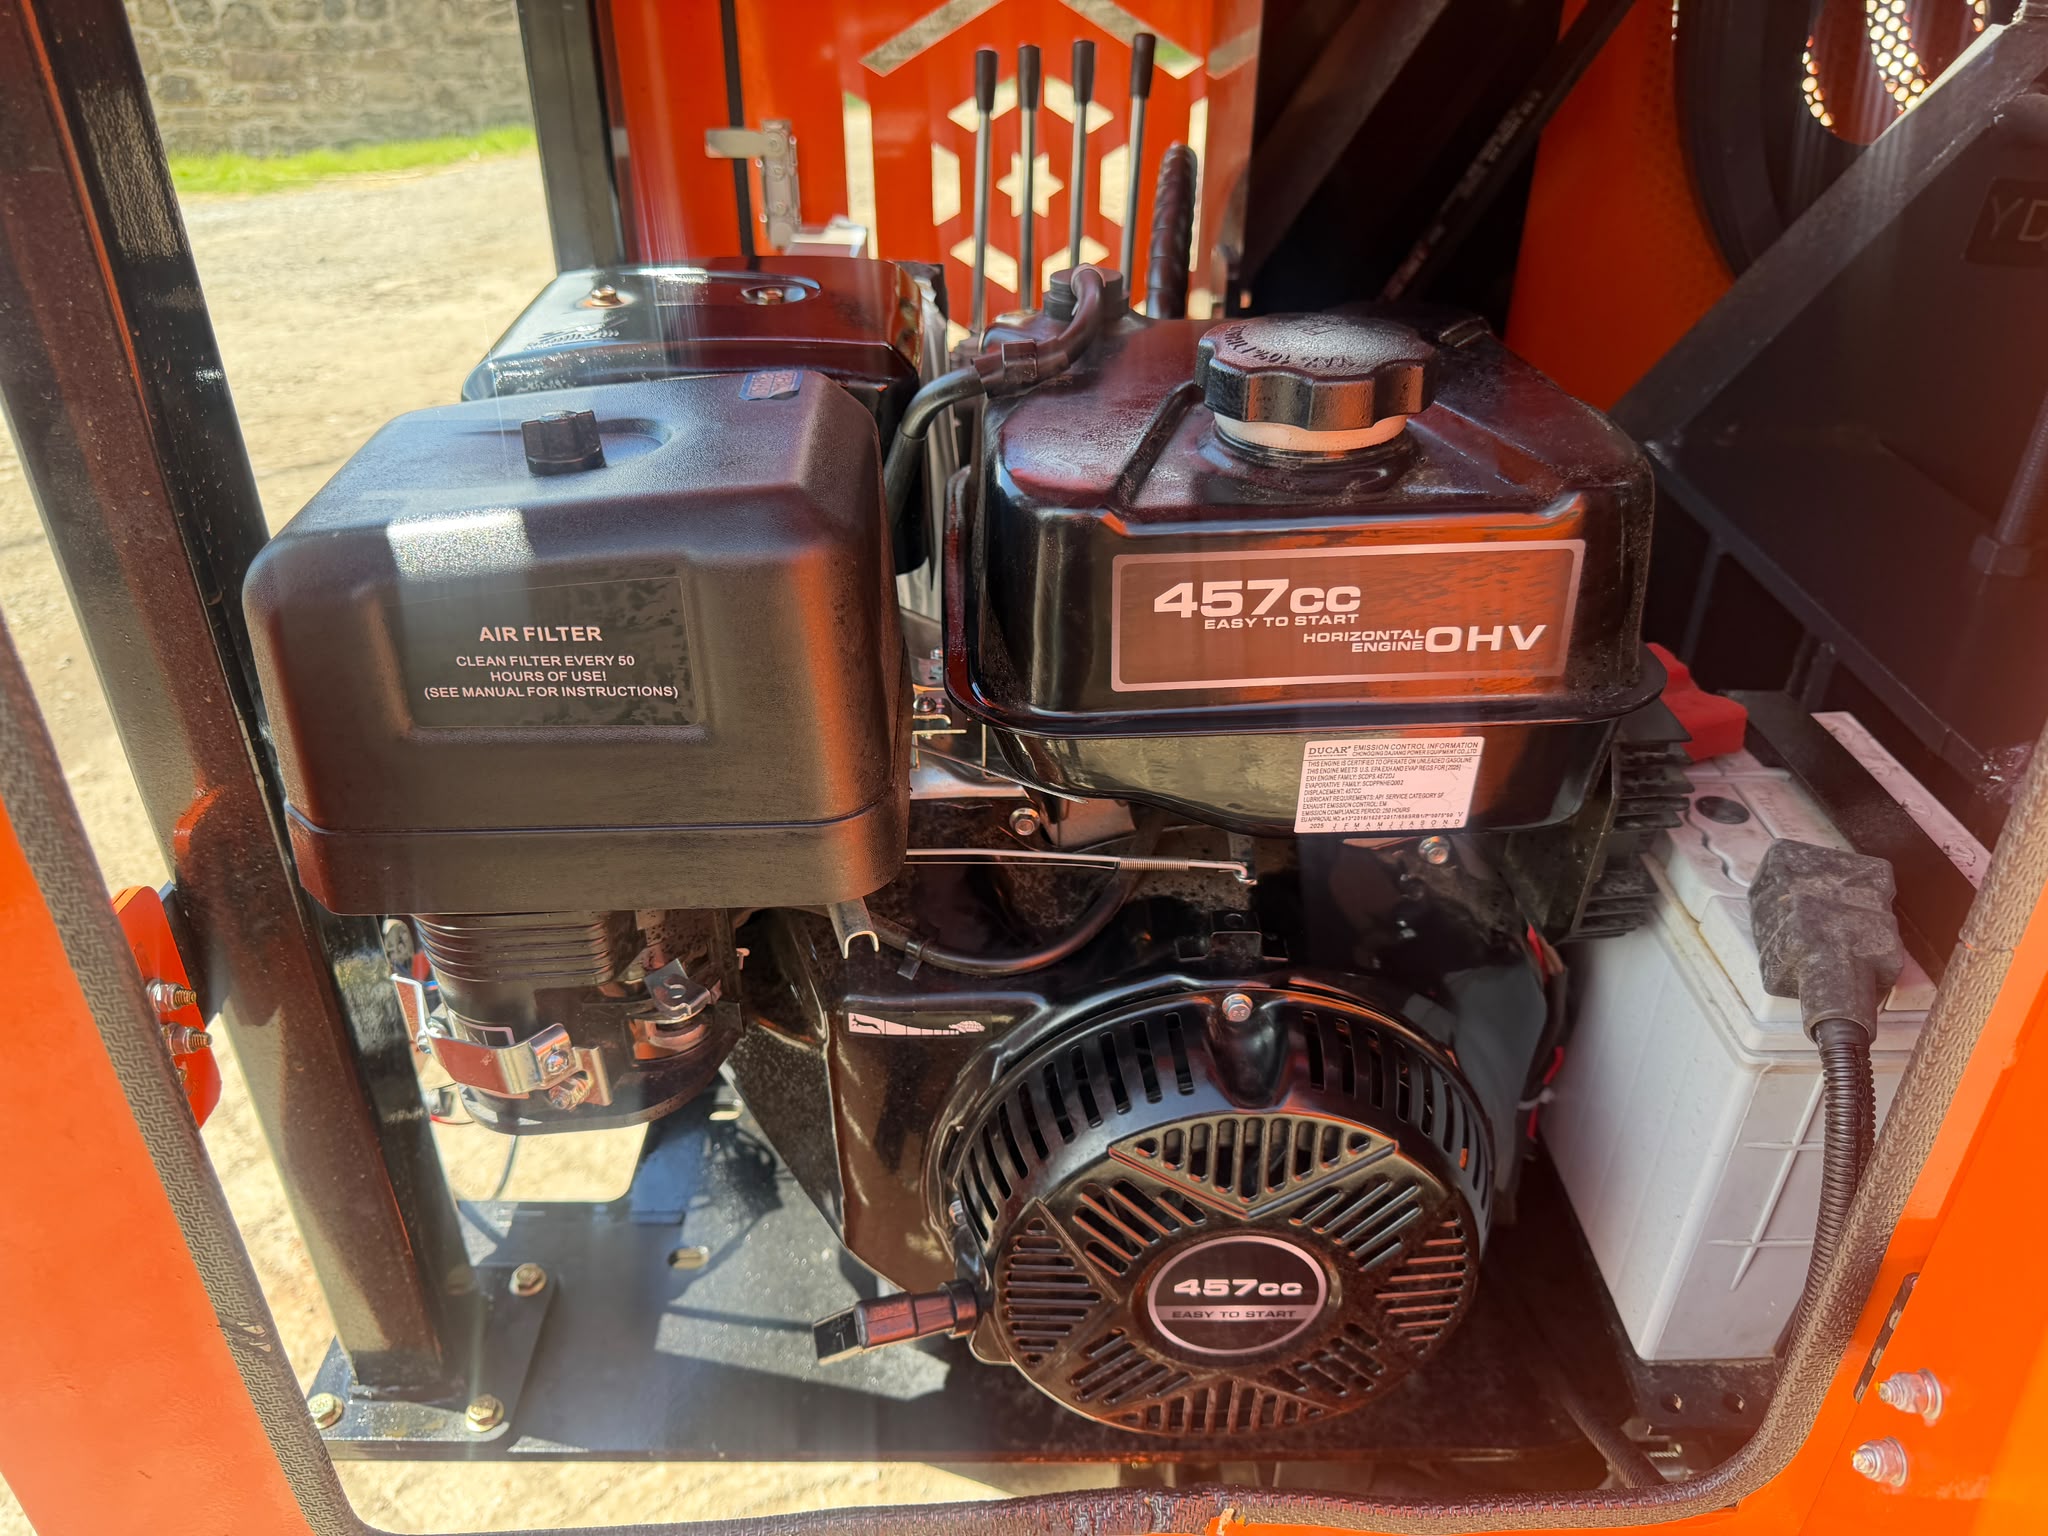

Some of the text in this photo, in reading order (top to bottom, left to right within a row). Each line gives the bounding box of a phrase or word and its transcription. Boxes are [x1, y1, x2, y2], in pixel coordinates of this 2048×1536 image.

[1154, 578, 1361, 618] 457cc
[1204, 614, 1359, 630] EASY TO START
[479, 626, 603, 642] AIR FILTER
[1303, 629, 1425, 644] HORIZONTAL
[1425, 624, 1547, 653] OHV
[1351, 640, 1424, 653] ENGINE
[456, 655, 635, 667] CLEAN FILTER EVERY 50
[490, 670, 607, 682] HOURS OF USE!
[424, 686, 679, 700] (SEE MANUAL FOR INSTRUCTIONS)
[1173, 1279, 1303, 1296] 457cc
